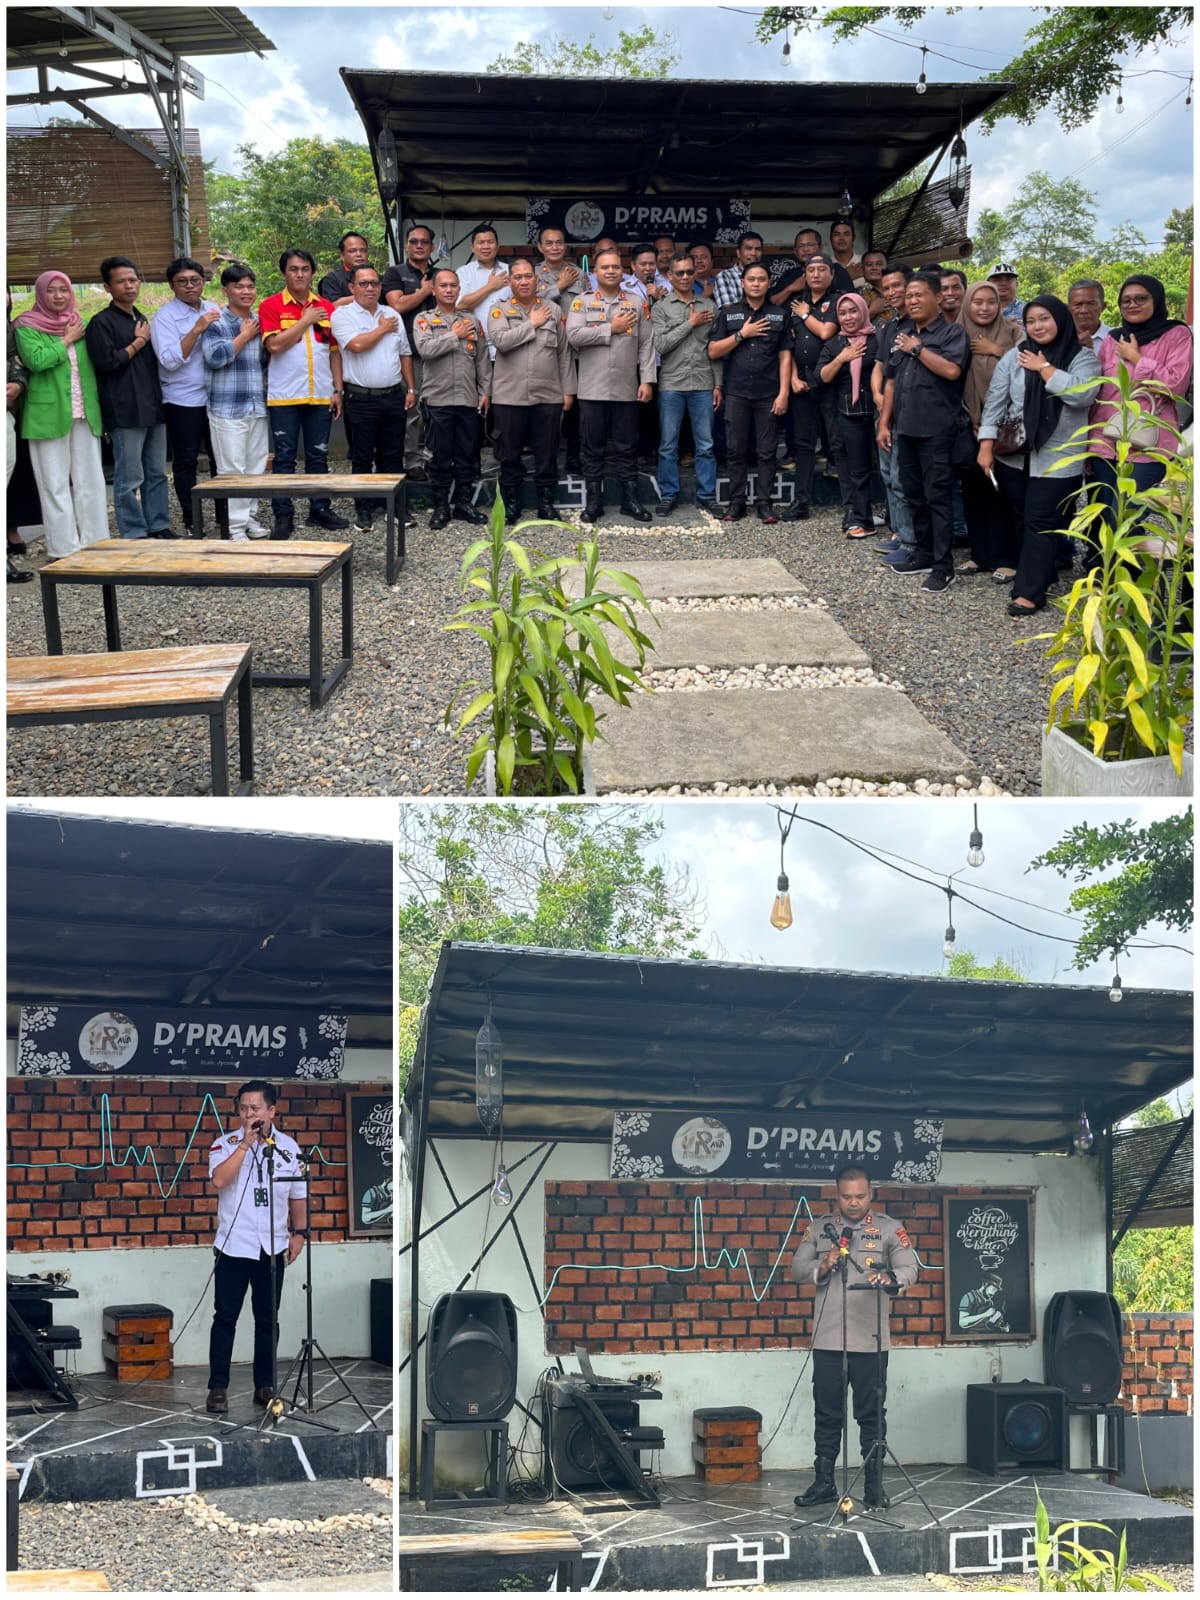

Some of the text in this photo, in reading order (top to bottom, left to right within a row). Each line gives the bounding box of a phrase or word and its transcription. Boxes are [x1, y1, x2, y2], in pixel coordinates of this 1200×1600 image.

[994, 264, 1014, 272] NYC
[153, 1022, 288, 1049] D'PRAMS
[370, 1104, 393, 1122] coff
[746, 1127, 882, 1153] D'PRAMS
[967, 1208, 1006, 1226] coffee
[956, 1223, 1019, 1245] everything
[968, 1239, 1008, 1252] better
